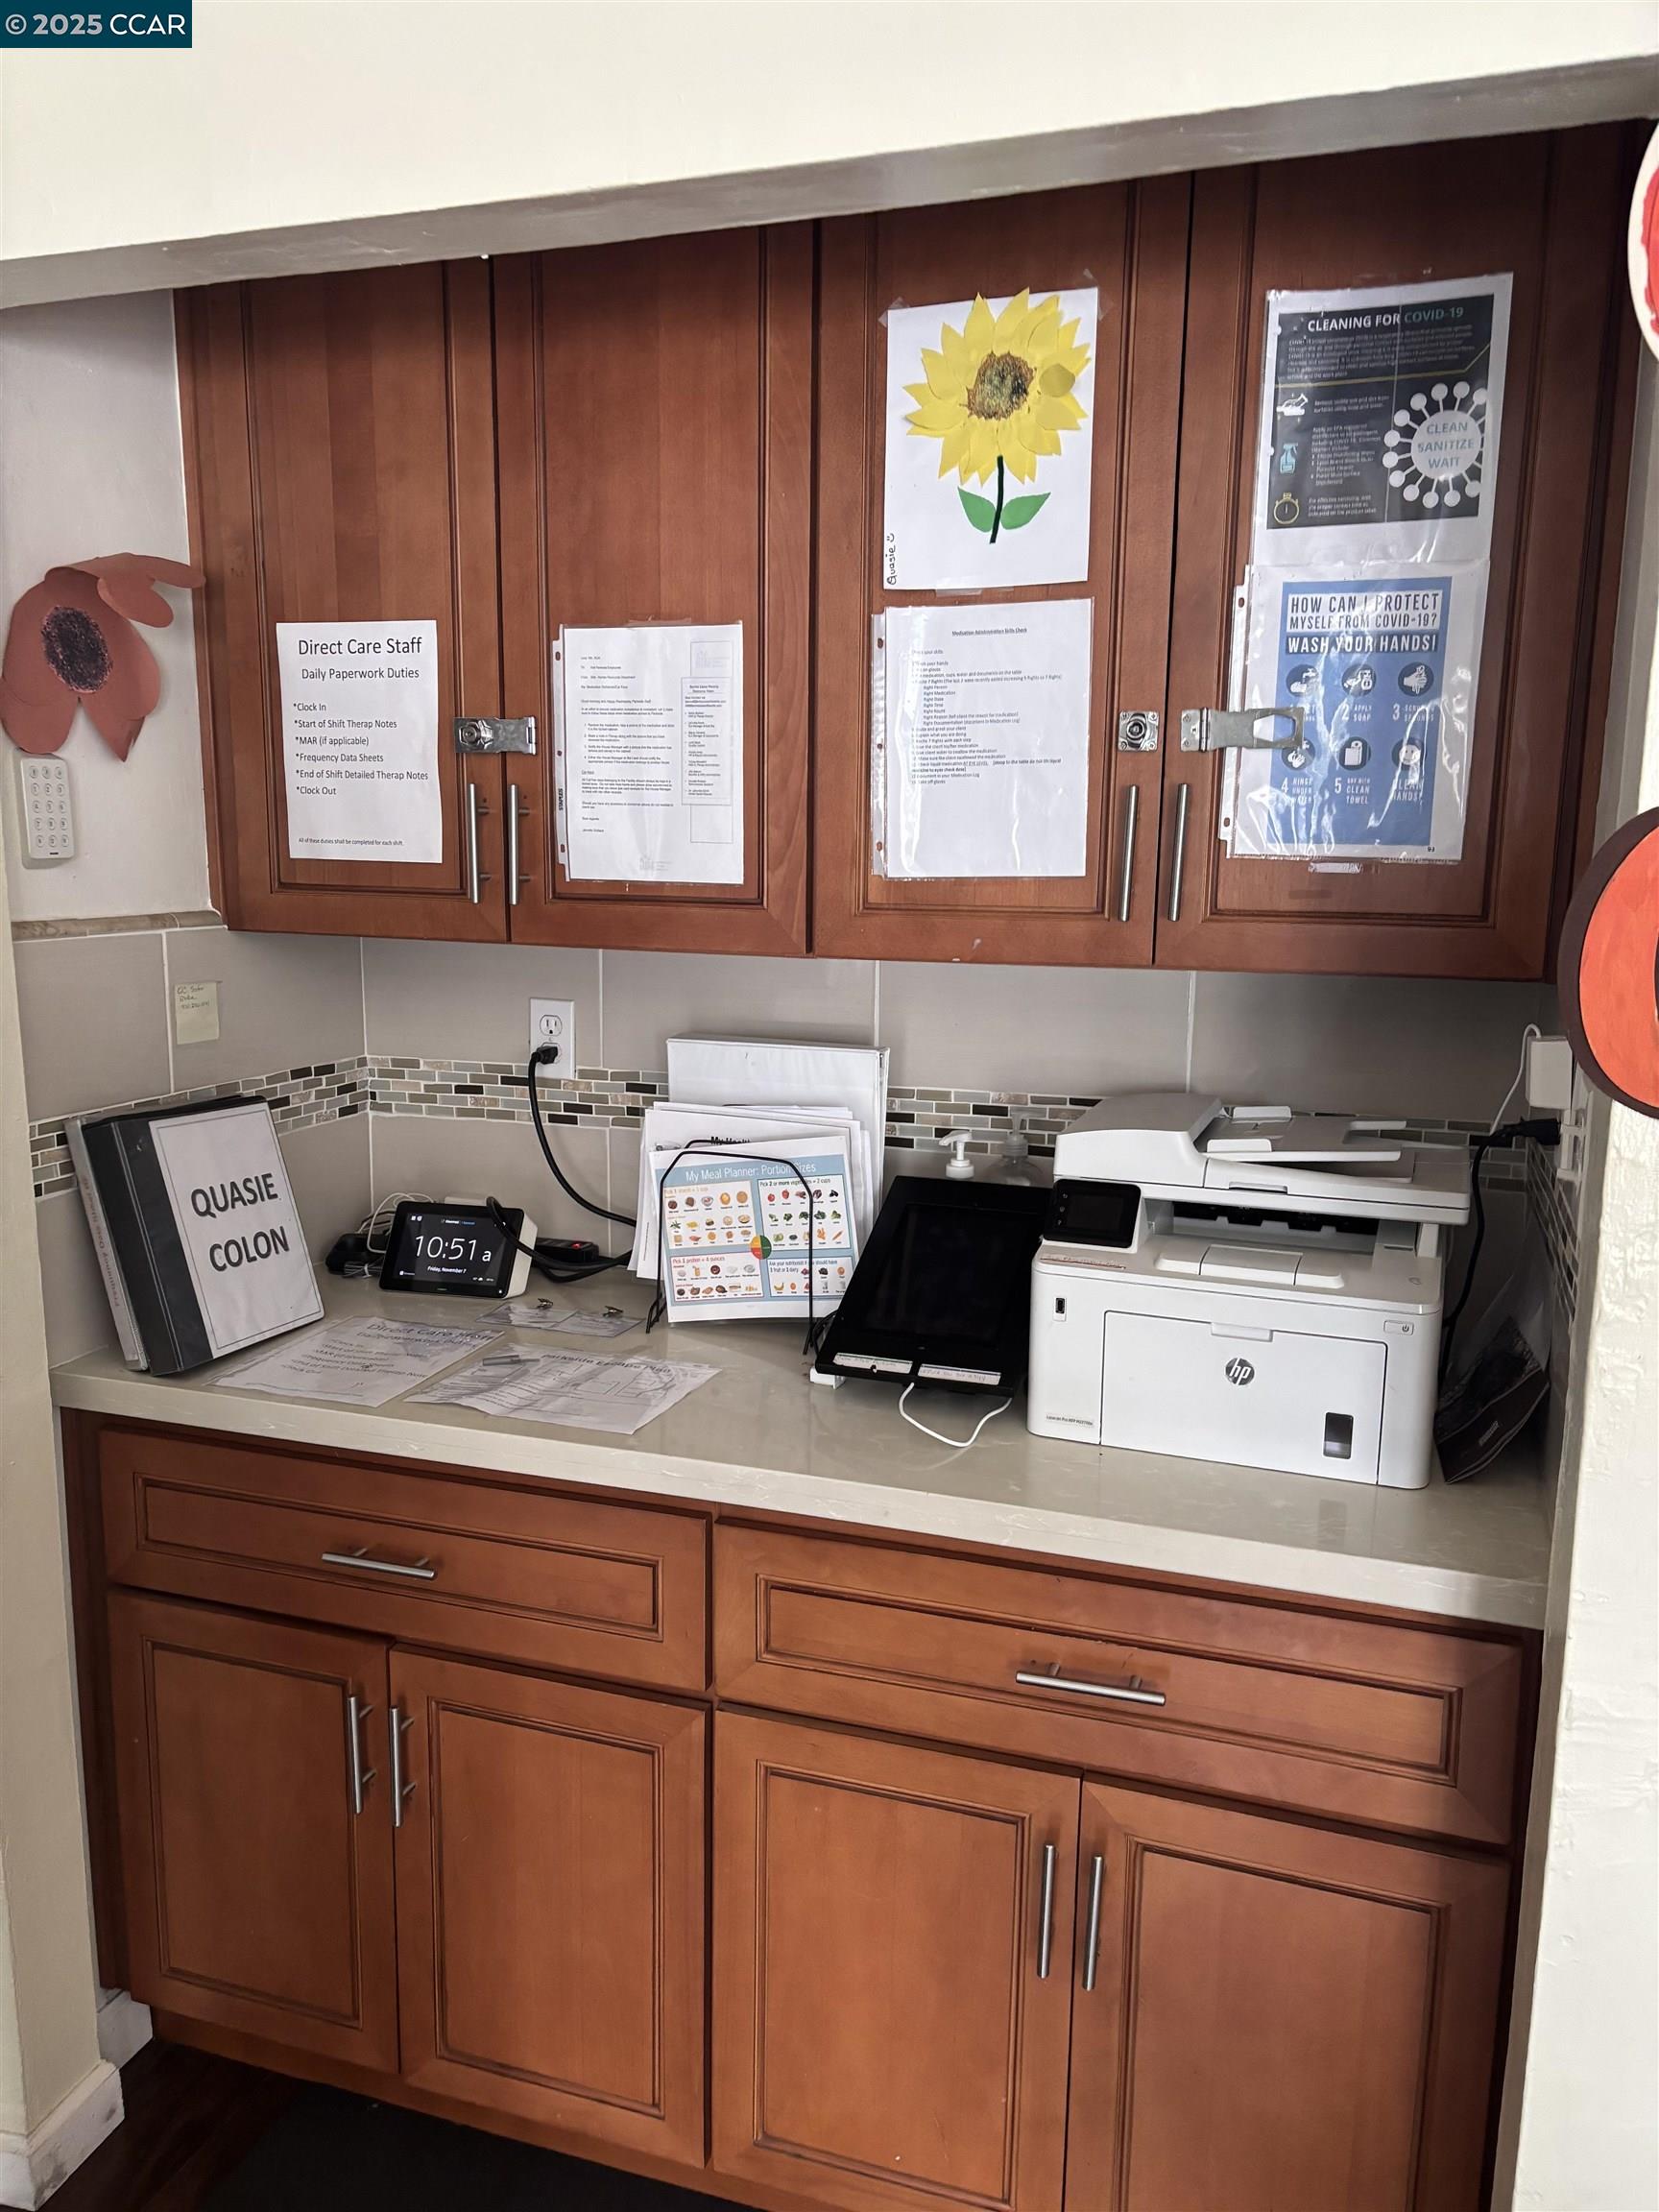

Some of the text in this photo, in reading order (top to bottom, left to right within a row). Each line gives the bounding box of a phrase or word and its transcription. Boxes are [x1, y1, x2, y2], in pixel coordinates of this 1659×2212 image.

[1308, 315, 1372, 333] CLEANING
[1375, 313, 1401, 326] FOR
[1427, 421, 1468, 435] CLEAN
[1417, 439, 1475, 453] SANITIZE
[1428, 456, 1460, 469] WAIT
[1291, 597, 1322, 613] HOW
[1329, 596, 1357, 613] CAN
[1375, 593, 1439, 612] PROTECT
[1289, 613, 1437, 631] MYSELF FROM COVID-19?
[299, 637, 422, 655] Direct Care Staff
[1288, 635, 1436, 653] WASH YOUR HANDS!
[301, 666, 420, 682] Daily Paperwork Duties
[319, 703, 326, 711] In
[1342, 703, 1349, 721] 2
[1392, 703, 1401, 721] 3
[318, 720, 326, 729] of
[327, 719, 346, 729] Shift
[347, 720, 373, 730] Therap
[374, 720, 397, 729] Notes
[319, 736, 327, 746] (if
[329, 736, 370, 747] applicable)
[341, 753, 357, 762] Data
[359, 753, 384, 762] Sheets
[316, 770, 324, 779] of
[325, 769, 343, 780] Shift
[345, 770, 375, 780] Detailed
[376, 770, 404, 781] Therap
[406, 771, 429, 781] Notes
[322, 786, 337, 795] Out
[1281, 778, 1288, 794] 4
[1334, 777, 1342, 794] 5
[1346, 785, 1370, 795] CLEAN
[1346, 796, 1368, 805] TOWEL
[685, 1171, 699, 1183] My
[701, 1168, 722, 1180] Meal
[724, 1166, 758, 1178] Planner:
[761, 1164, 791, 1176] Portion
[190, 1172, 279, 1219] QUASIE
[209, 1226, 290, 1272] COLON
[415, 1236, 492, 1262] 10:51 a
[367, 1324, 415, 1334] Direct
[596, 1360, 641, 1370] Escape
[1229, 1358, 1252, 1385] hp
